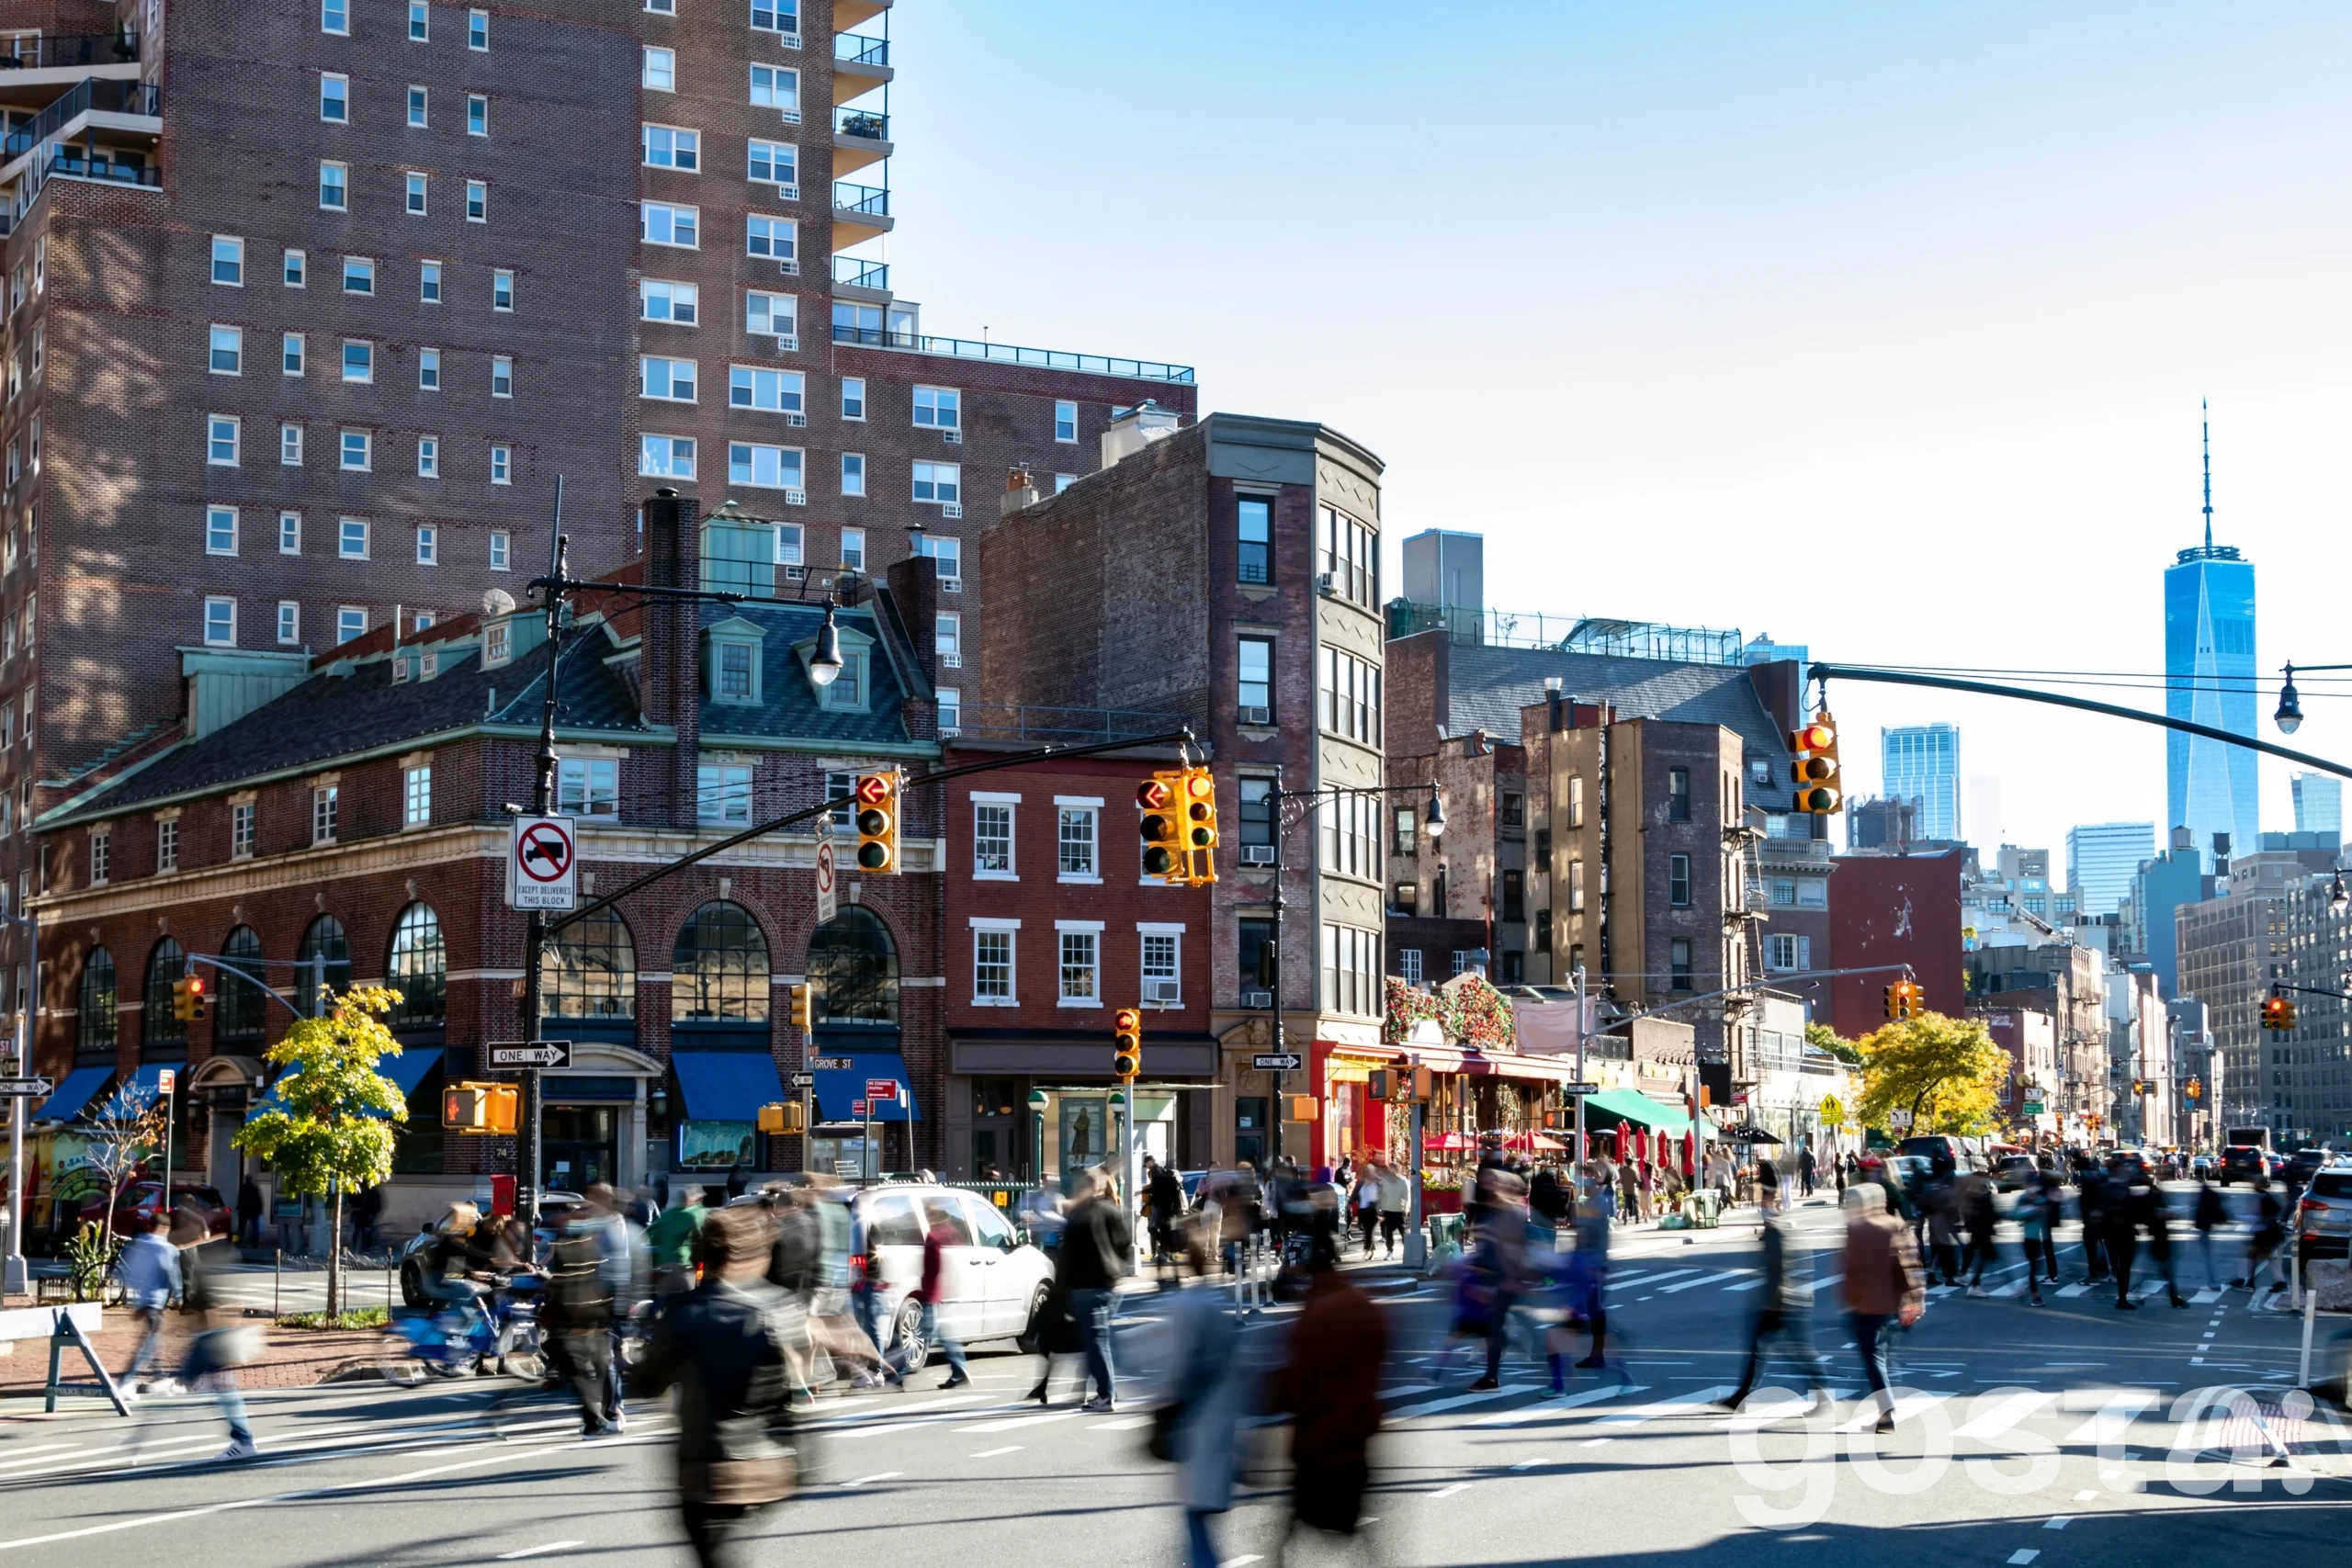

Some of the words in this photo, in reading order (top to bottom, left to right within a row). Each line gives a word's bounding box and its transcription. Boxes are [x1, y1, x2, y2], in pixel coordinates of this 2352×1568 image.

[518, 886, 538, 895] EXCEPT
[540, 886, 571, 895] DELIVERIES
[524, 897, 539, 905] THIS
[542, 897, 565, 905] BLOCK
[0, 1040, 10, 1052] ST
[499, 1051, 524, 1061] ONE
[534, 1050, 558, 1061] WAY
[814, 1059, 839, 1069] GROVE
[842, 1059, 852, 1069] ST
[496, 1148, 507, 1157] 74
[55, 1387, 80, 1396] POLICE
[83, 1388, 103, 1397] DEPT
